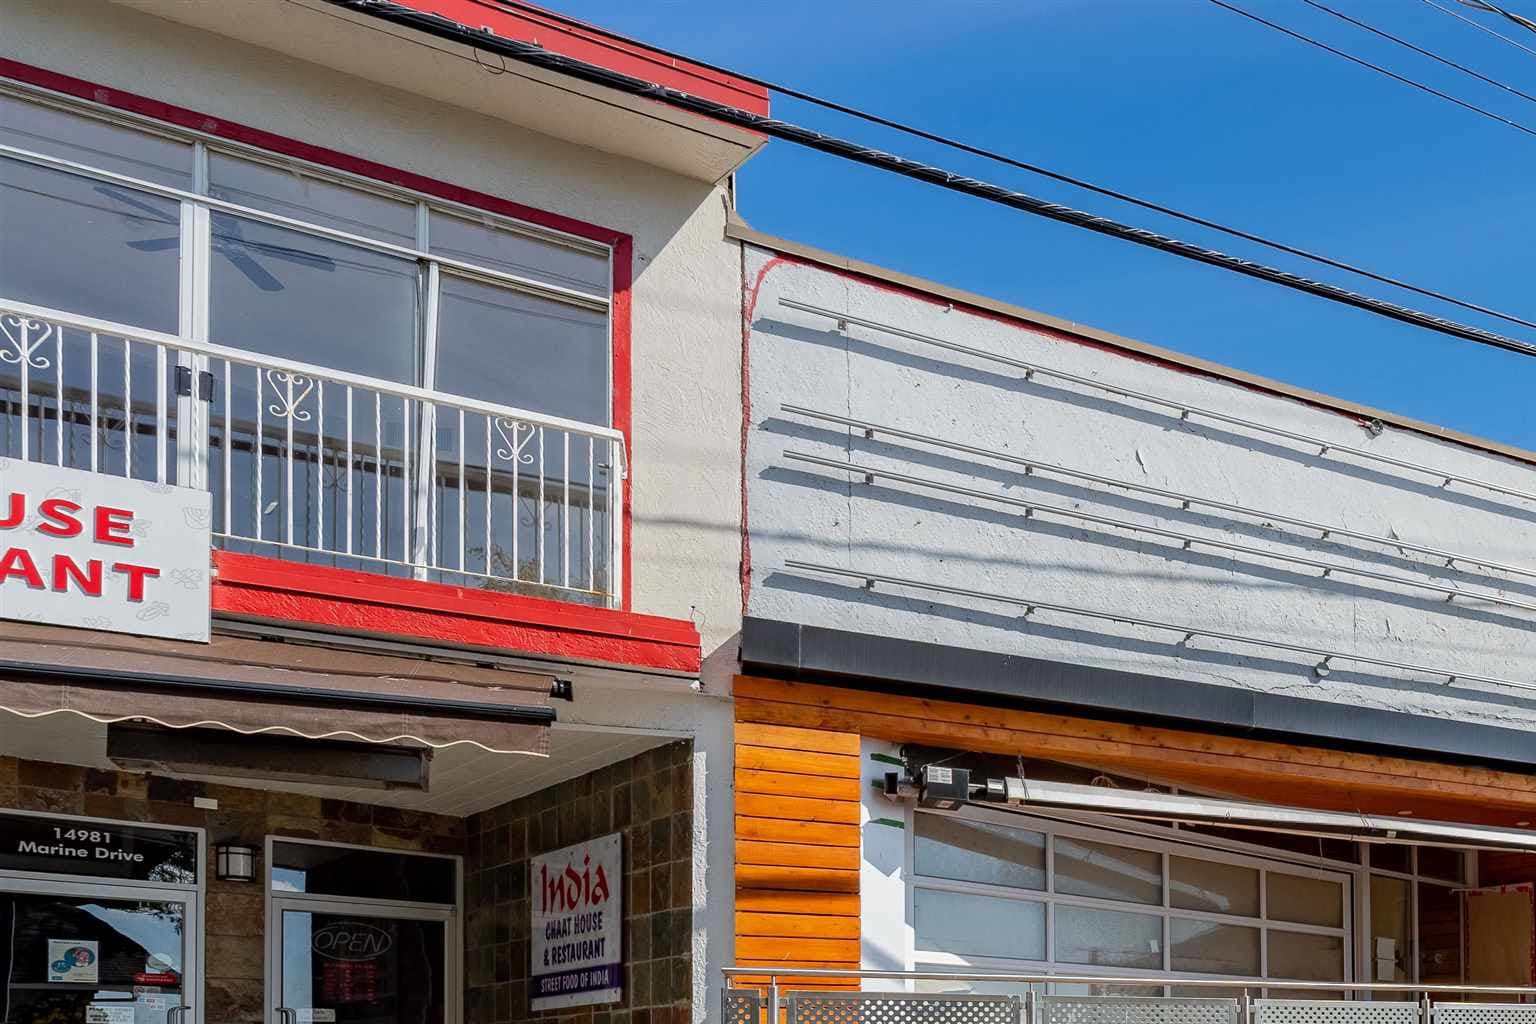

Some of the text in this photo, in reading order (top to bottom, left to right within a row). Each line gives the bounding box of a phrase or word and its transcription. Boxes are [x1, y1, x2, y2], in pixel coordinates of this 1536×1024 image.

[0, 492, 135, 548] USE
[0, 547, 161, 603] ANT
[53, 827, 112, 844] 14981
[18, 840, 145, 863] Marine Drive
[541, 853, 609, 916] India
[545, 911, 603, 941] CHAAT HOUSE
[315, 931, 385, 953] OPEN
[543, 937, 606, 966] & RESTAURANT
[541, 969, 609, 993] STREET FOOD OF INDIA
